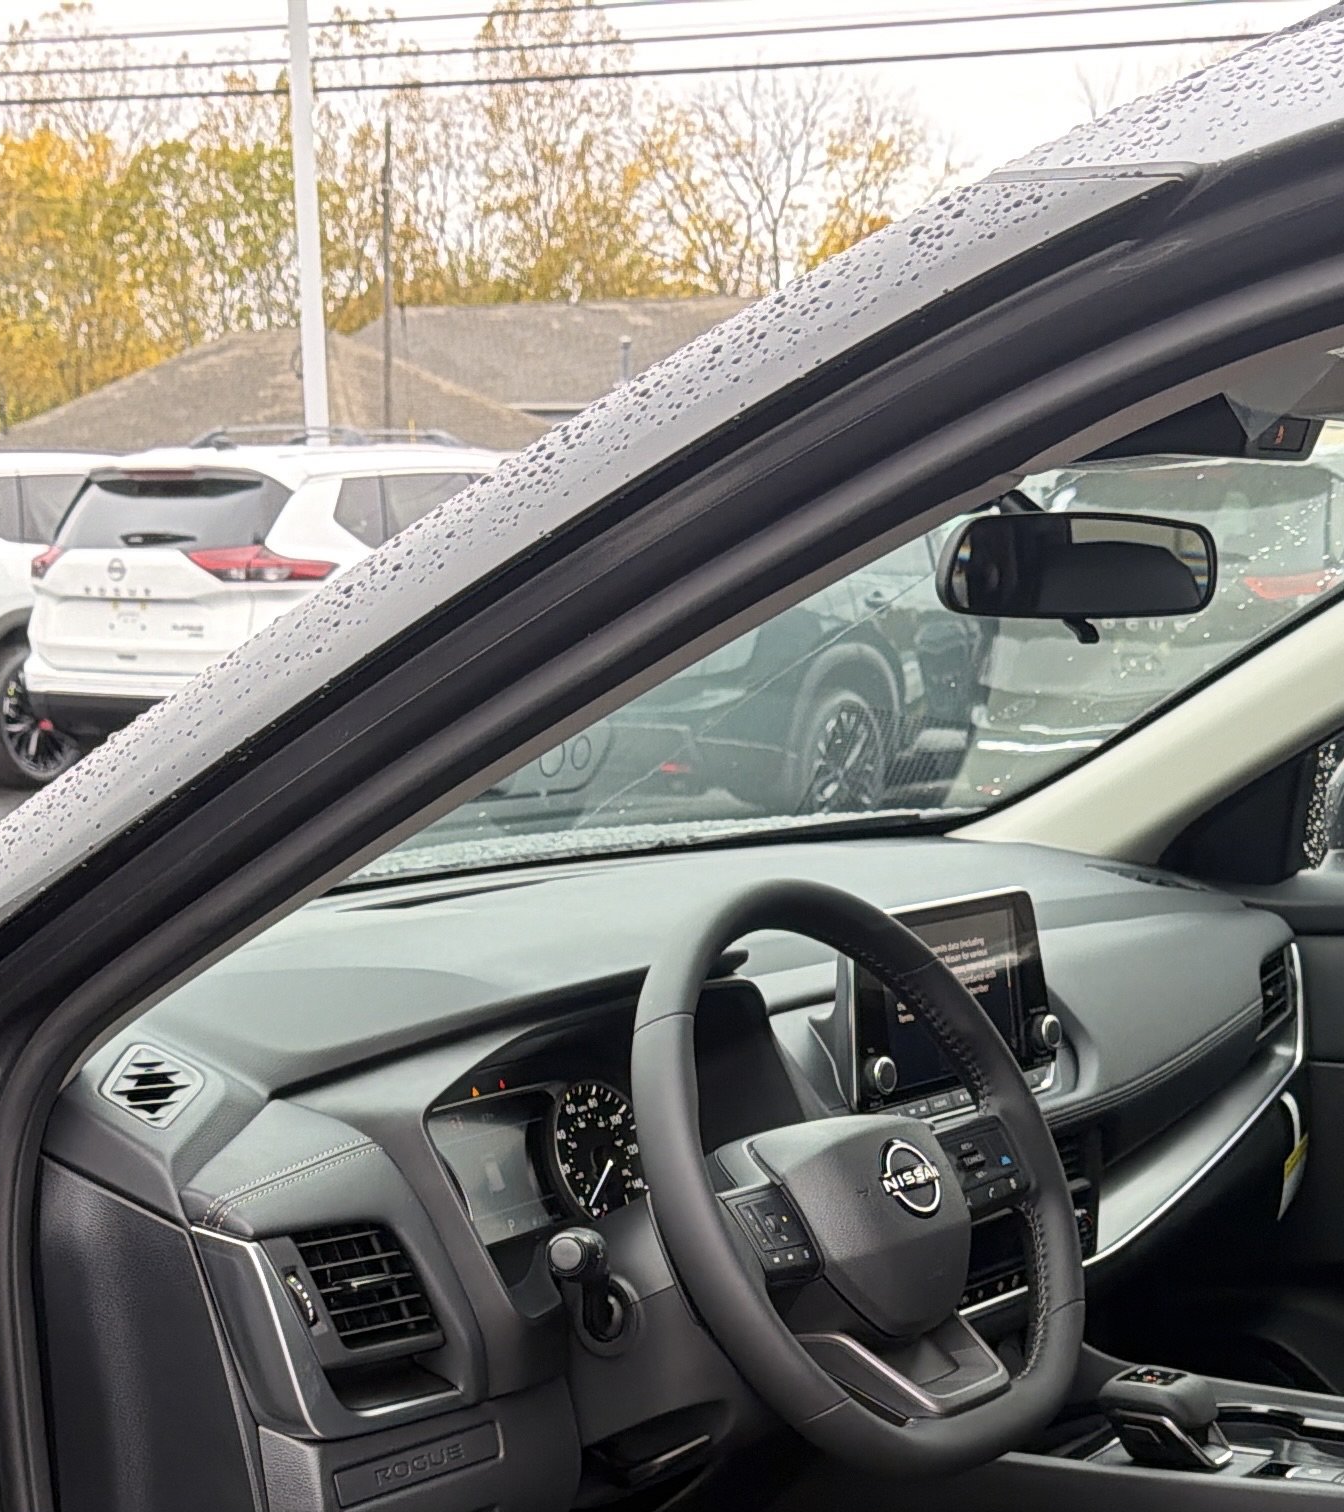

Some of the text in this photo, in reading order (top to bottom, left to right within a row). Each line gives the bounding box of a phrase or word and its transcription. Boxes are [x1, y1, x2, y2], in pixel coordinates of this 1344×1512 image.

[609, 1113, 623, 1126] 100
[627, 1143, 639, 1155] 120
[882, 1166, 940, 1193] NISSAN
[374, 1443, 465, 1487] ROGUE
